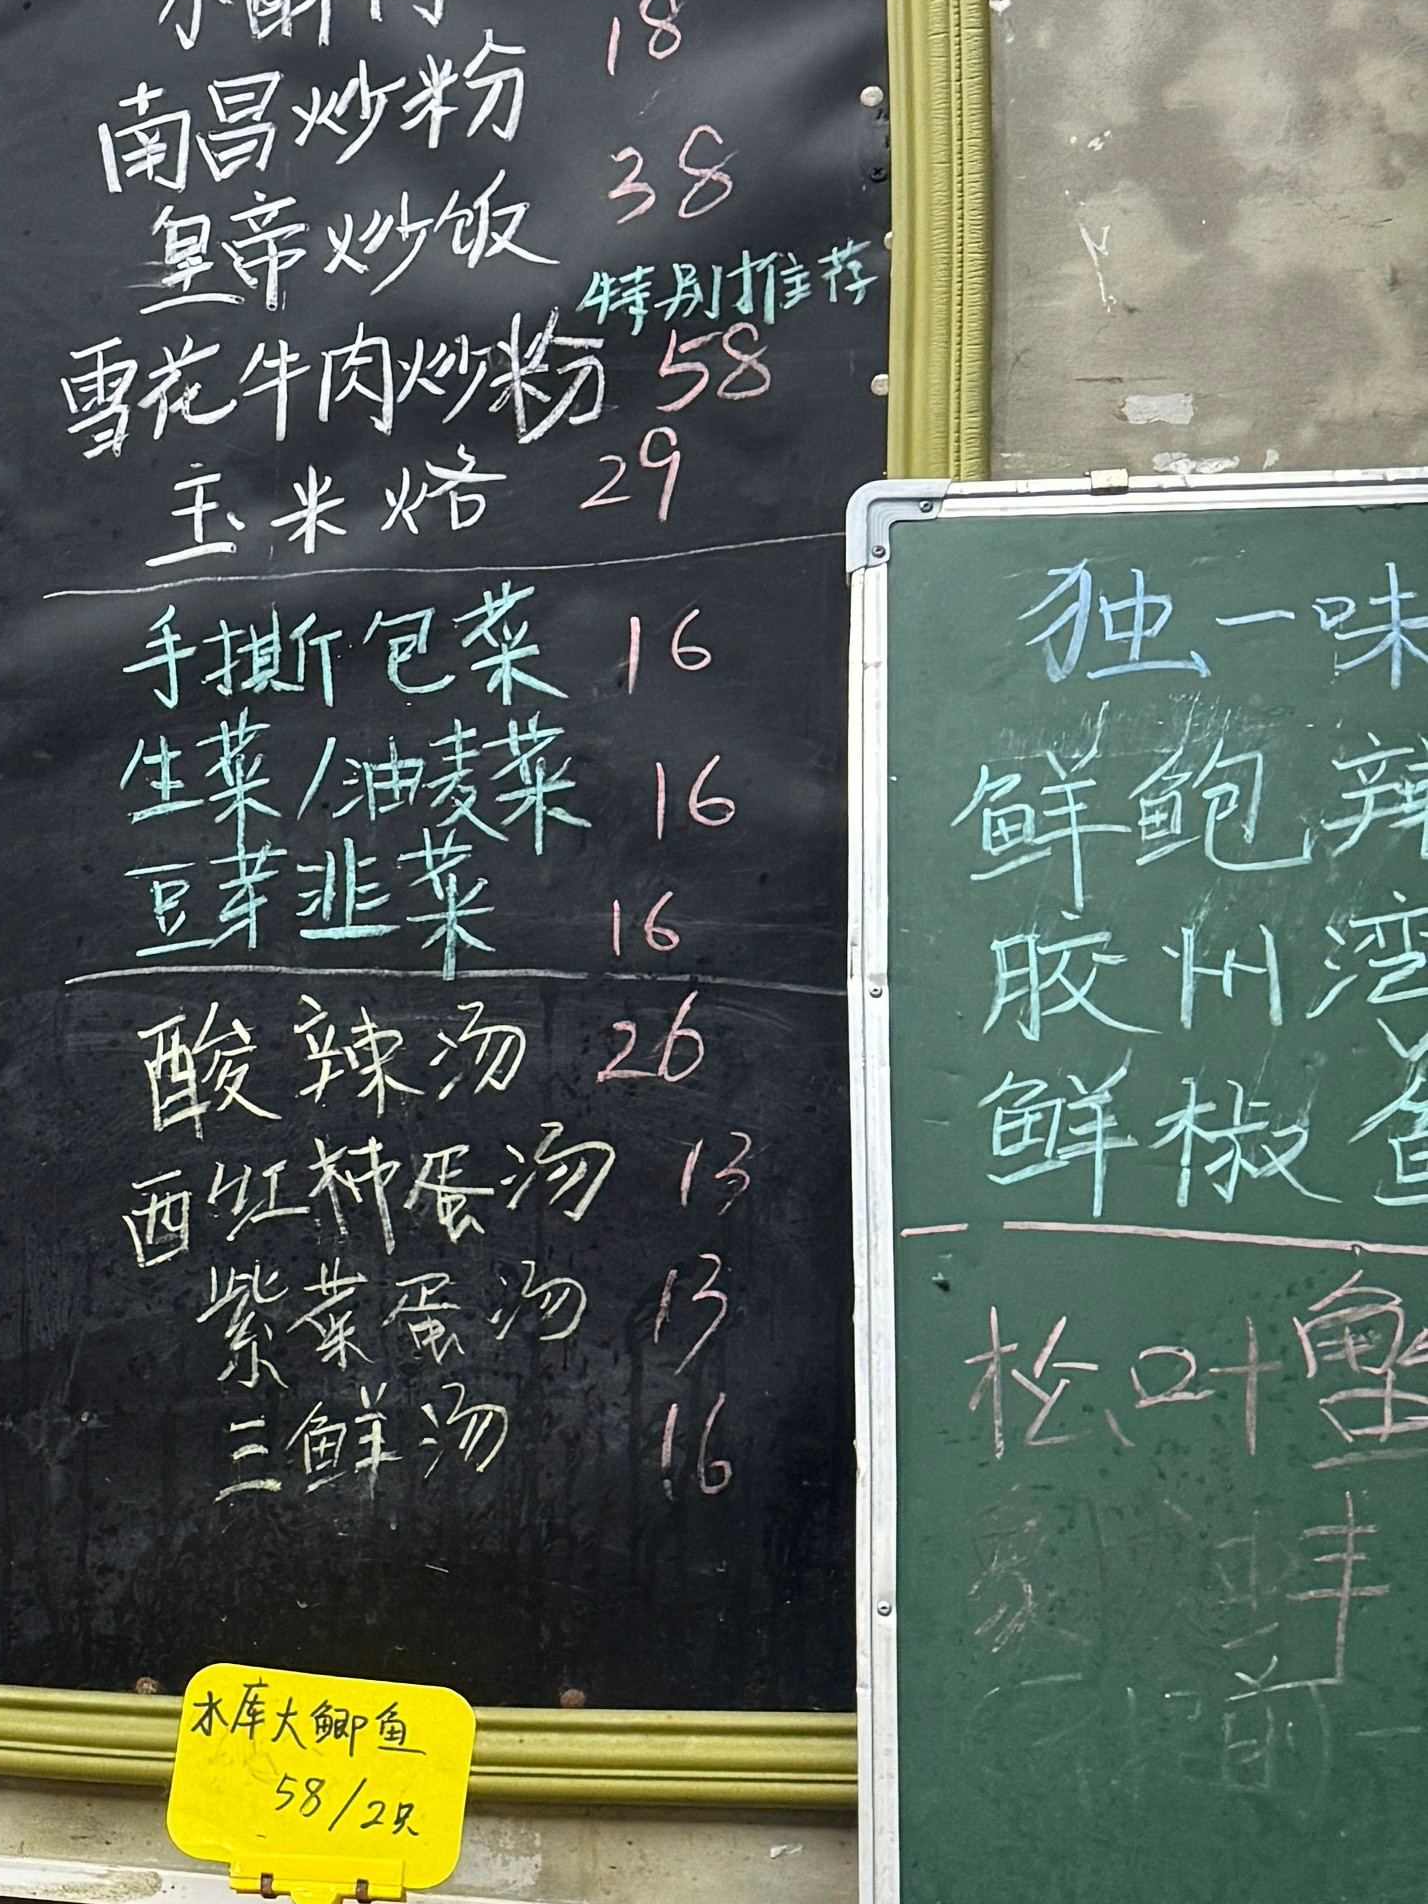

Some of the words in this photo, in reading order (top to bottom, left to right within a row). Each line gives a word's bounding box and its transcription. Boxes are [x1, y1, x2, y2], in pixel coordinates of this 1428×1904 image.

[98, 28, 528, 193] 南昌炒粉
[139, 169, 560, 315] 皇帝炒饭
[575, 241, 878, 335] 特别推荐
[61, 306, 617, 459] 雪花牛肉炒粉
[122, 580, 569, 709] 手撕包菜
[1017, 562, 1428, 690] 独一味
[125, 826, 495, 981] 豆芽韭菜
[137, 994, 527, 1140] 酸辣汤
[121, 1122, 616, 1268] 西红柿蛋汤
[195, 1261, 588, 1390] 紫菜蛋汤
[214, 1382, 510, 1503] 三鲜汤
[191, 1688, 428, 1760] 水库大鲫鱼
